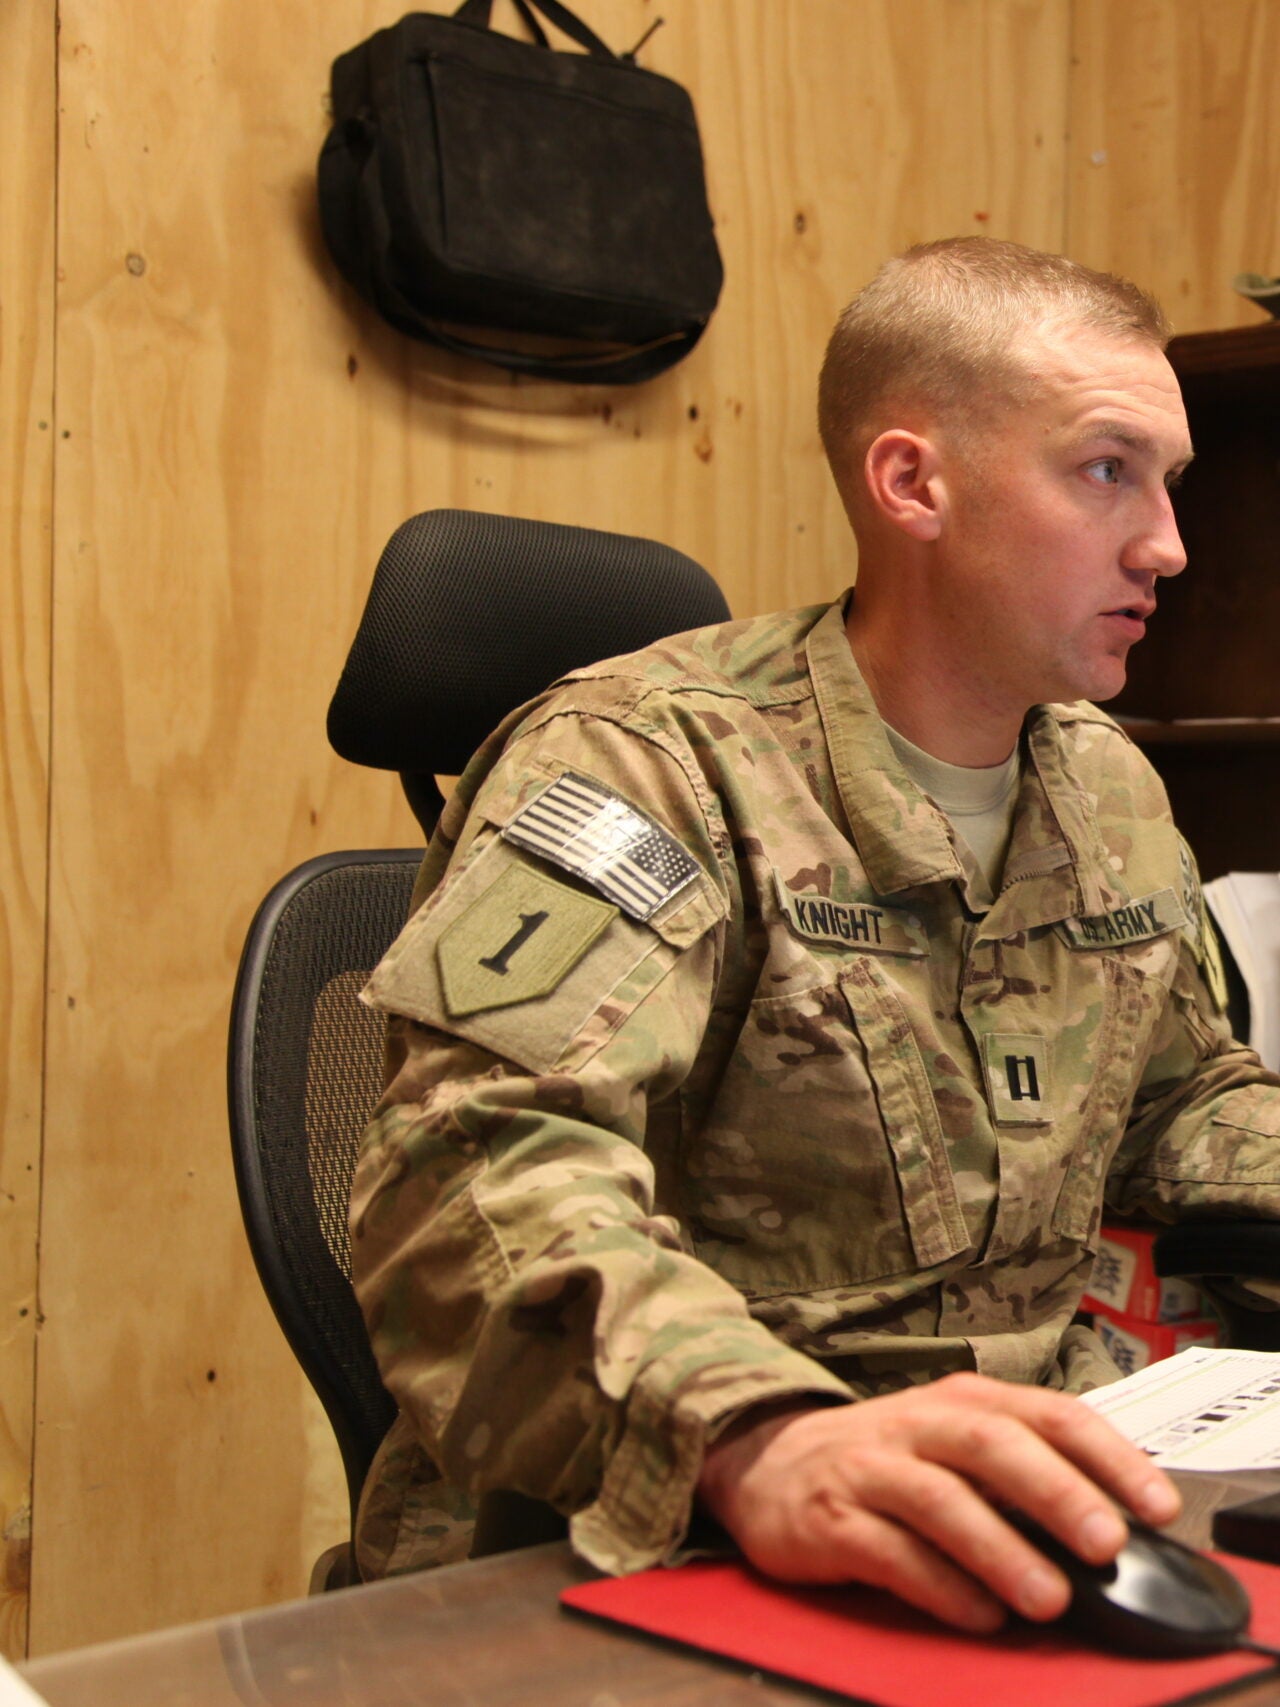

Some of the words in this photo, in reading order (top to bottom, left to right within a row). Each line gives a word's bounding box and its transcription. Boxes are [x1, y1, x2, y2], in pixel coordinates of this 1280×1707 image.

[478, 910, 550, 976] 1
[794, 898, 883, 944] KNIGHT
[1103, 900, 1158, 941] ARMY
